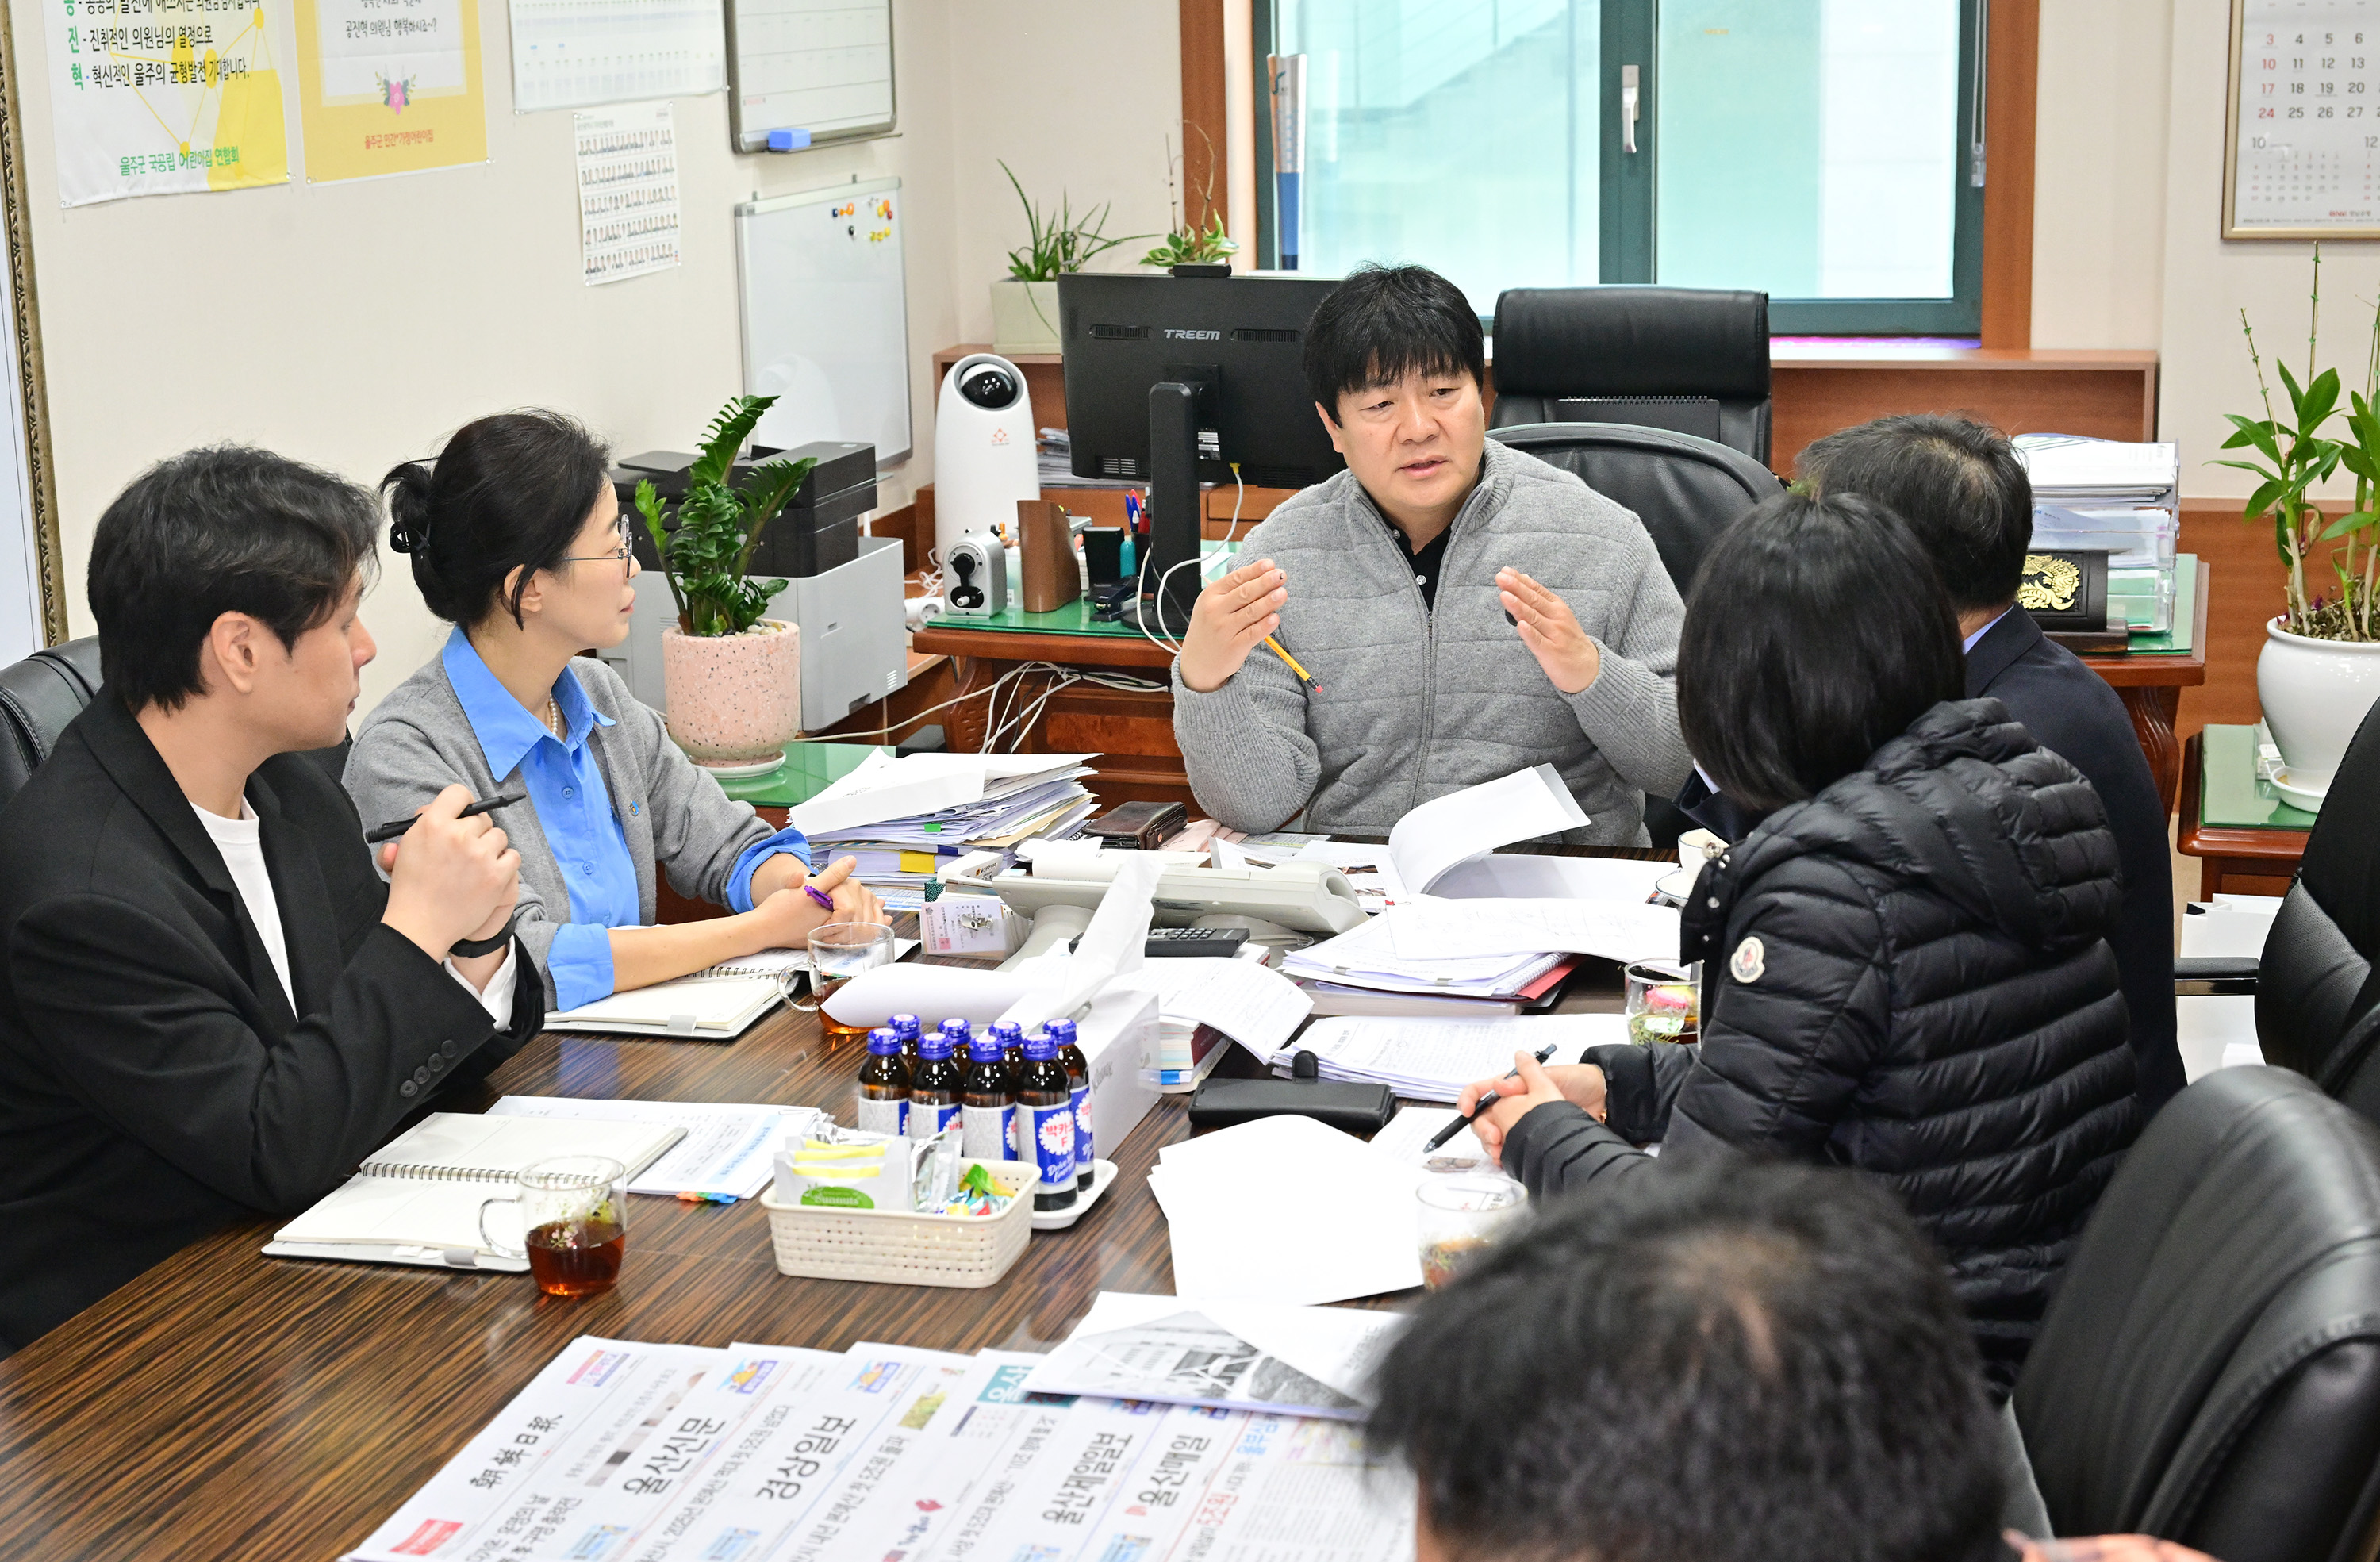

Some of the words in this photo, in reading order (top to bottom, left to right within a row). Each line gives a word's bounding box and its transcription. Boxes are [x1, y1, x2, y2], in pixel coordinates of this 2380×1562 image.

[370, 19, 391, 37] 의원님
[67, 25, 79, 54] 진
[90, 27, 129, 52] 진취적인
[132, 25, 175, 50] 의원님의
[178, 25, 213, 48] 열정으로
[2266, 34, 2274, 45] 3
[2295, 33, 2303, 44] 4
[2325, 33, 2333, 44] 5
[2355, 33, 2363, 44] 6
[2262, 58, 2276, 70] 10
[2293, 58, 2304, 69] 11
[2321, 57, 2335, 69] 12
[2351, 57, 2365, 69] 13
[71, 63, 83, 91] 혁
[91, 63, 130, 89] 혁신적인
[134, 62, 166, 86] 울주의
[169, 60, 206, 84] 균형발전
[2262, 83, 2274, 94] 17
[2291, 83, 2304, 94] 18
[2320, 82, 2334, 94] 19
[2348, 82, 2365, 94] 20
[2259, 107, 2274, 119] 24
[2288, 107, 2304, 118] 25
[2317, 107, 2333, 118] 26
[2347, 106, 2363, 118] 27
[2251, 137, 2266, 148] 10
[2364, 136, 2378, 148] 12
[120, 155, 146, 176] 울주군
[148, 152, 175, 172] 국공립
[178, 148, 213, 170] 어린이집
[215, 145, 240, 166] 연합회
[1164, 329, 1220, 340] TREEM
[1061, 1137, 1068, 1147] F
[623, 1418, 727, 1495] 울산신문
[755, 1415, 857, 1500] 경상일보
[1042, 1433, 1133, 1524] 울산제일일보
[1138, 1435, 1211, 1506] 울산매일
